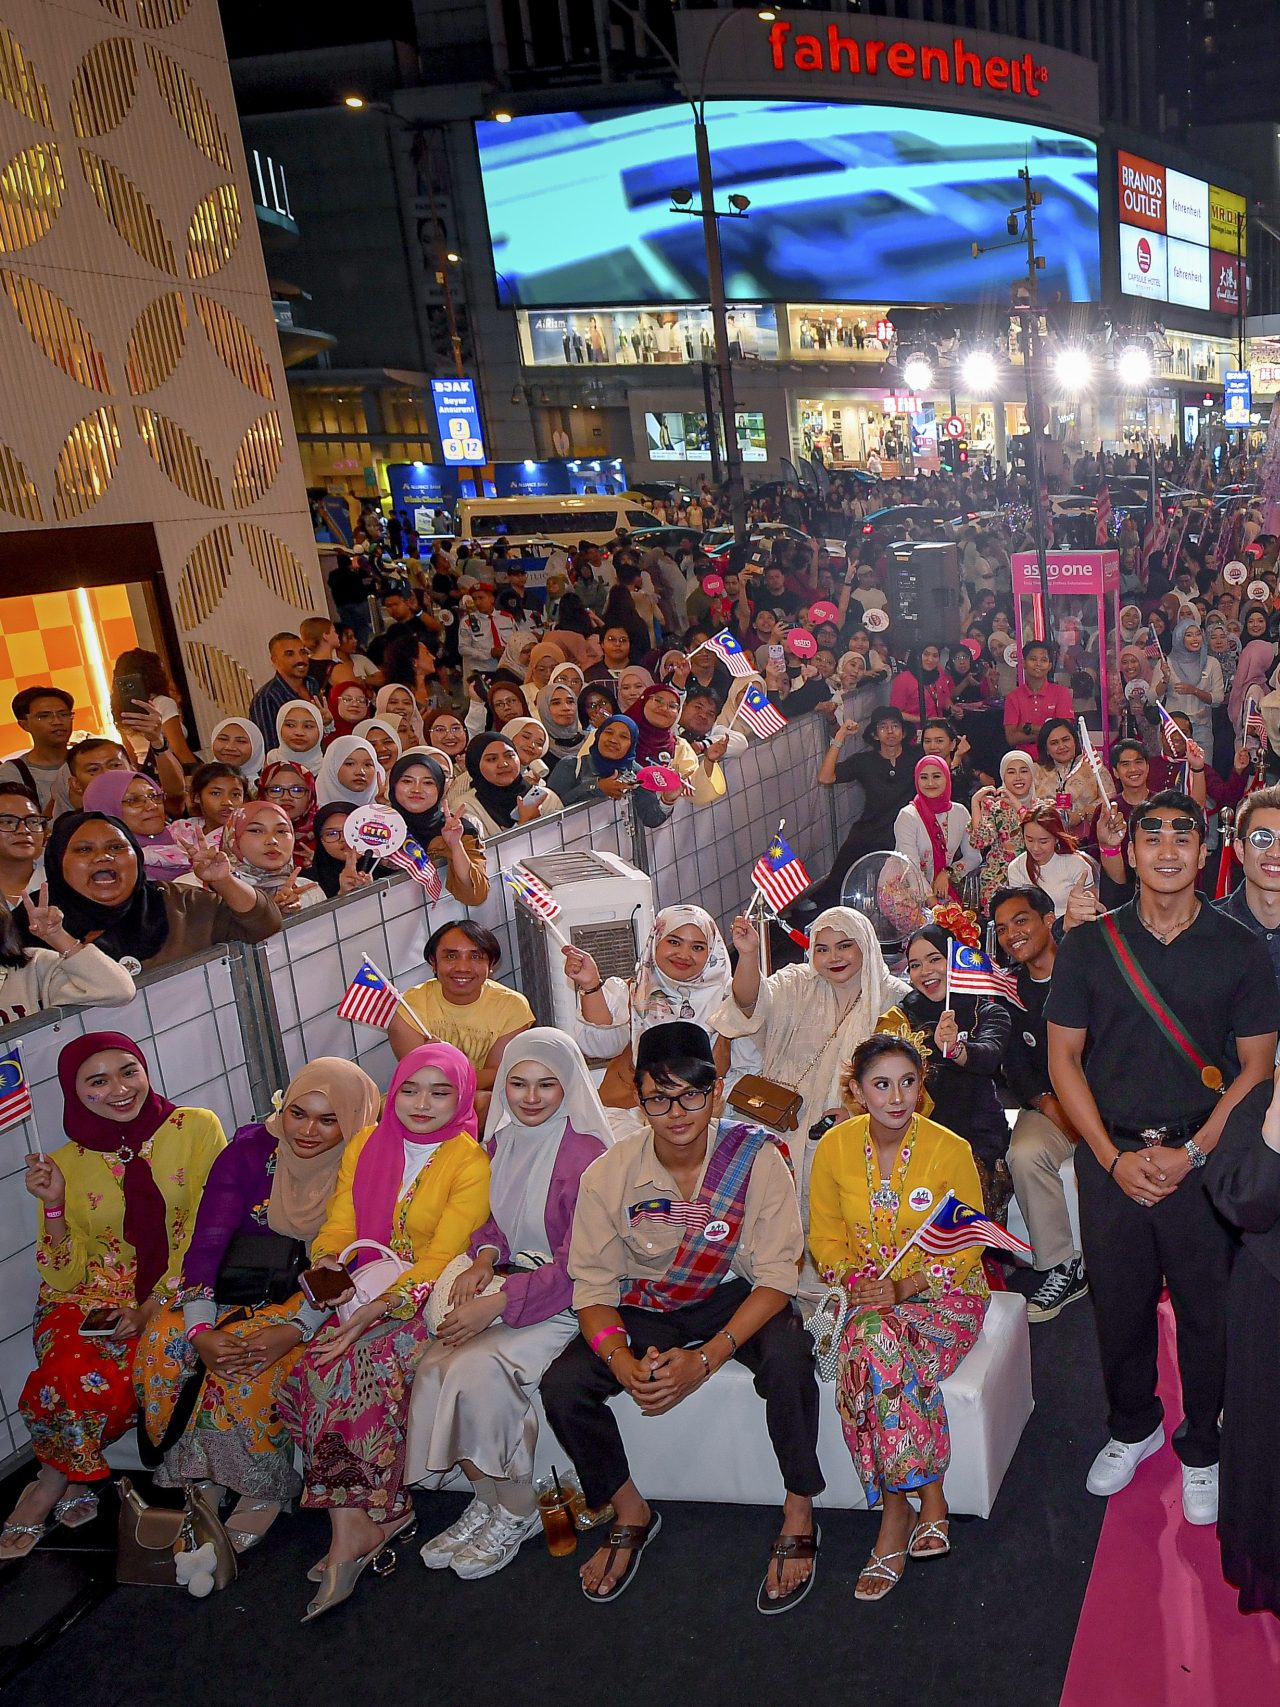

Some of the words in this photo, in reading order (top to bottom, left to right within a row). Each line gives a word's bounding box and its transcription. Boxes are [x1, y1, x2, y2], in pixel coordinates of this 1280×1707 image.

[769, 21, 1041, 97] fahrenheit
[1122, 166, 1162, 197] BRANDS
[1124, 189, 1161, 218] OUTLET
[1172, 199, 1201, 218] fahrenheit
[1128, 272, 1147, 284] CAPSULE
[1147, 278, 1161, 287] HOTEL
[1173, 266, 1203, 283] fahrenheit
[456, 422, 462, 432] 3
[450, 443, 457, 452] 6
[467, 443, 478, 451] 12
[1024, 564, 1059, 579] asro
[1062, 564, 1093, 576] one
[793, 639, 811, 648] astro
